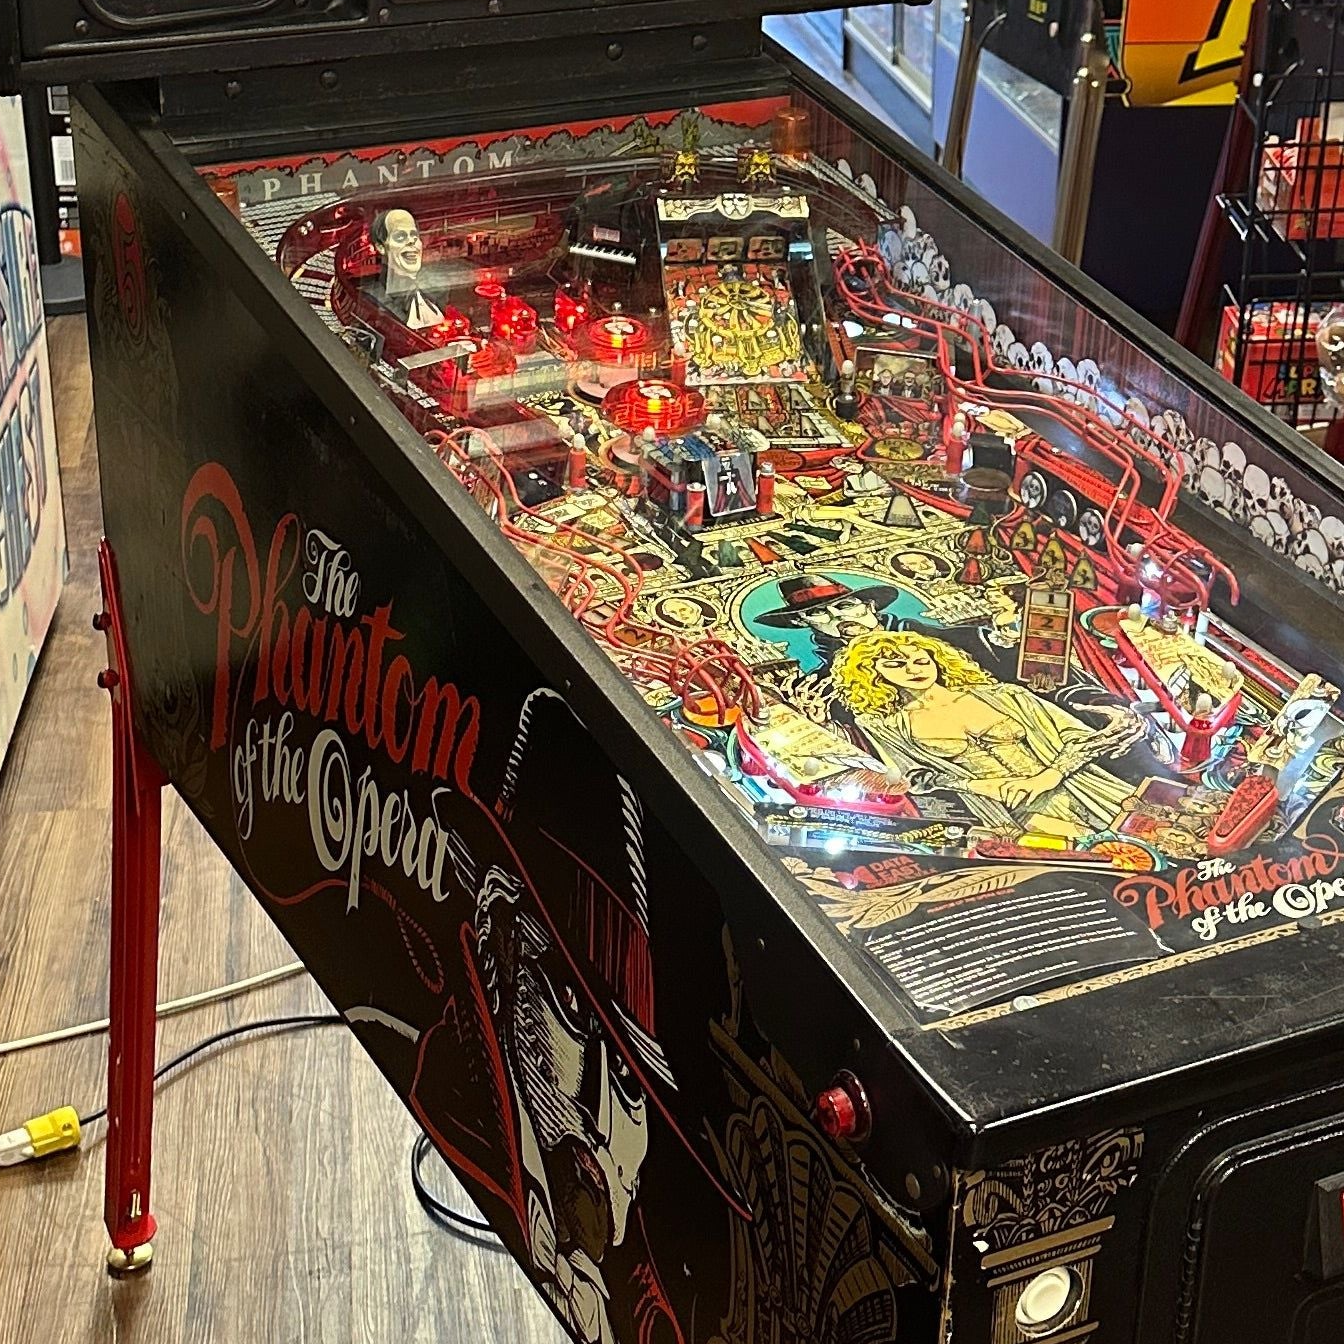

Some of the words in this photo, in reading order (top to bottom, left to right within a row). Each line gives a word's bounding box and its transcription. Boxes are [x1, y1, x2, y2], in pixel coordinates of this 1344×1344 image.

[262, 150, 514, 200] PHANTOM
[303, 528, 360, 618] The
[181, 461, 484, 798] Phantom
[230, 716, 260, 841] of
[258, 712, 307, 806] the
[308, 728, 456, 916] Opera
[868, 855, 915, 872] DATA
[875, 863, 924, 883] EAST
[1196, 857, 1237, 882] The
[1191, 906, 1227, 942] of
[1222, 891, 1272, 925] the
